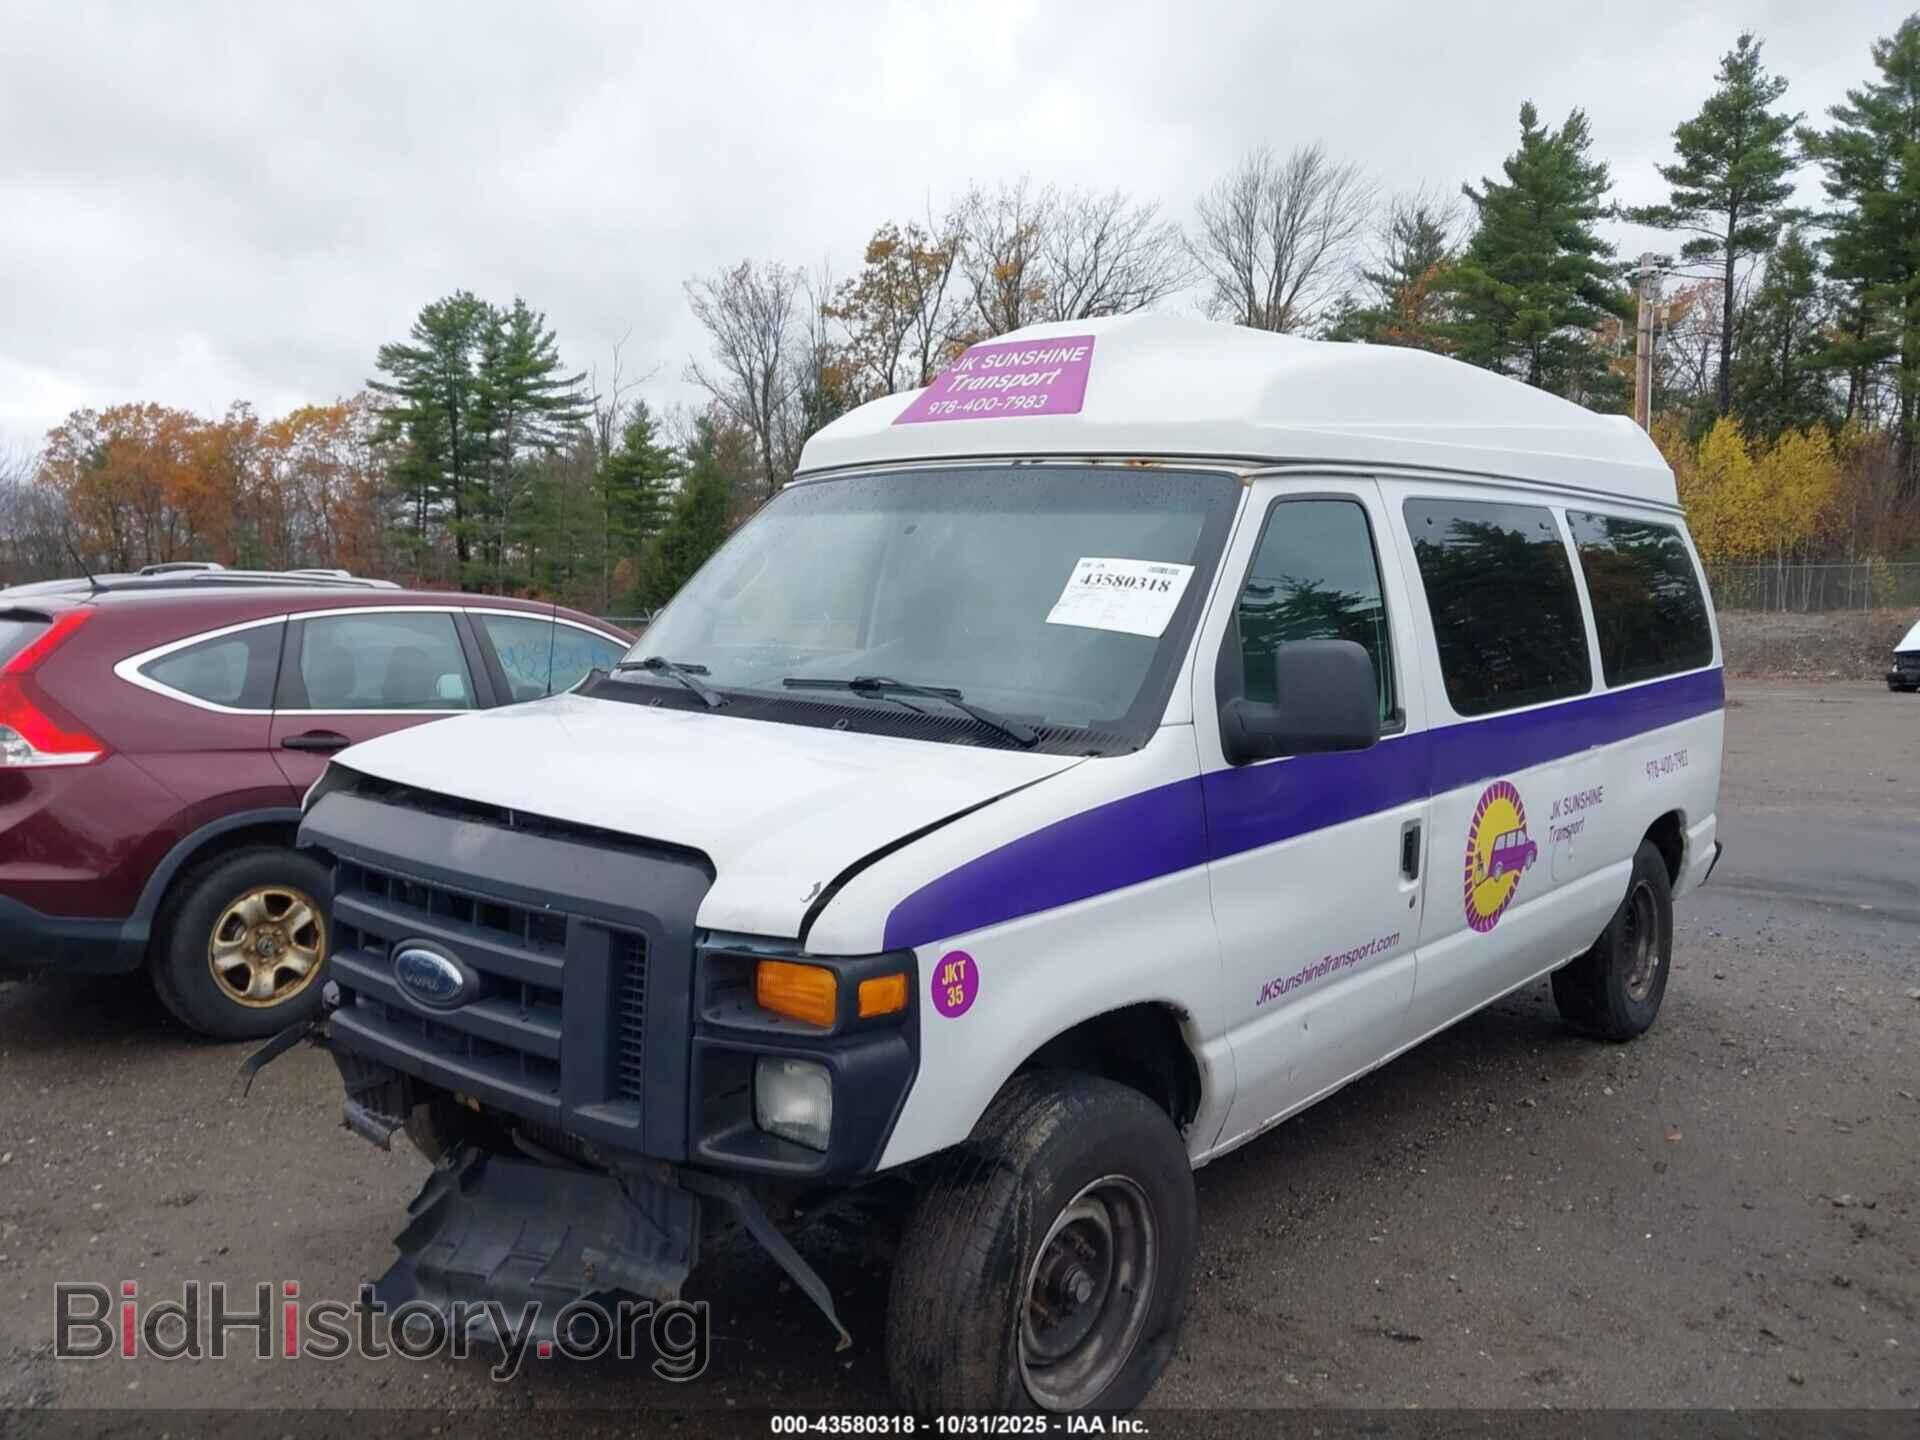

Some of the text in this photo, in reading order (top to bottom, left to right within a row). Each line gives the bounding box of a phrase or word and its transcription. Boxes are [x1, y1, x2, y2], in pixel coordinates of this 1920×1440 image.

[952, 346, 1089, 373] JK SUNSHINE
[946, 367, 1062, 393] Transport
[927, 394, 1049, 416] 978-400-7983
[1080, 573, 1172, 593] 43580318
[1550, 785, 1603, 820] JK SUNSHINE
[1549, 817, 1585, 843] Transport
[942, 959, 966, 986] JKT
[1256, 931, 1400, 1006] JKSunshineTransport.com
[947, 984, 964, 1008] 35
